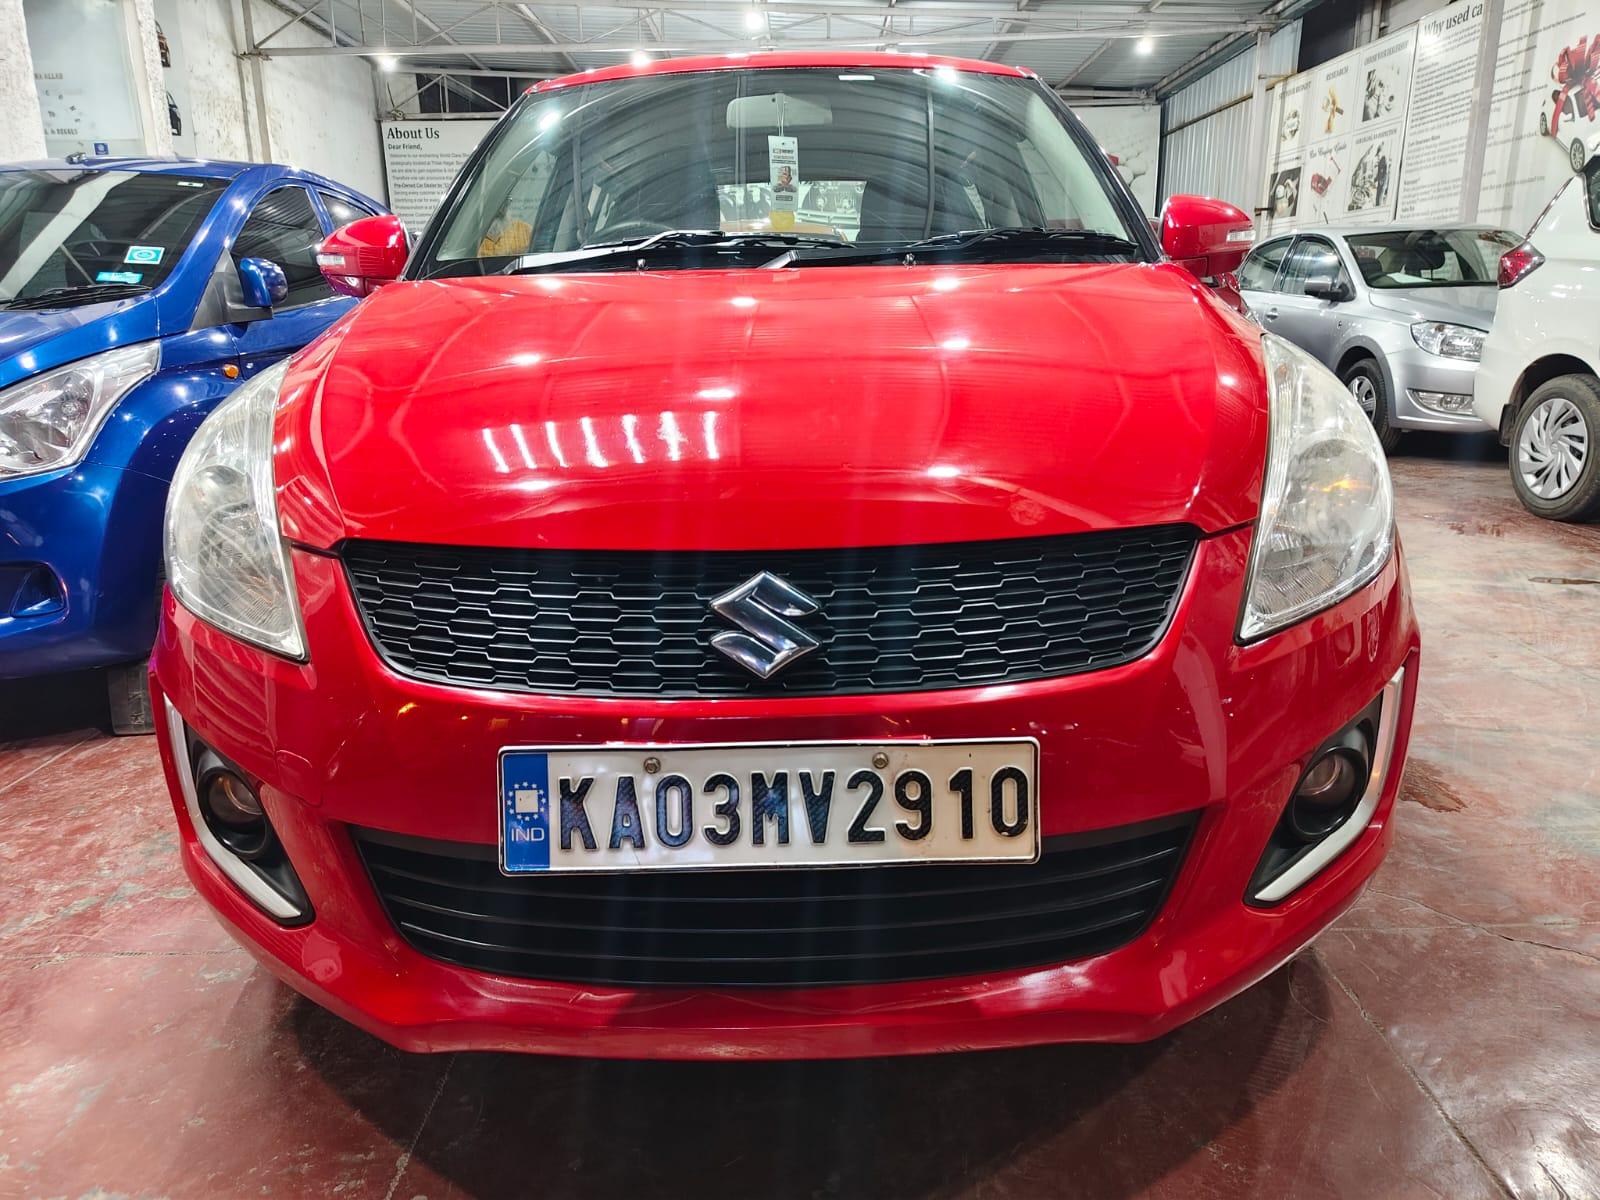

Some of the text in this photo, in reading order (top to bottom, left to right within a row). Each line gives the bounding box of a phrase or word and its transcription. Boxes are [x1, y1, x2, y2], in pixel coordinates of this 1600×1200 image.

[1446, 5, 1470, 30] used
[387, 127, 440, 139] About Us
[402, 143, 423, 151] Friend,
[558, 764, 1030, 850] KA03MV2910
[511, 825, 545, 843] IND
